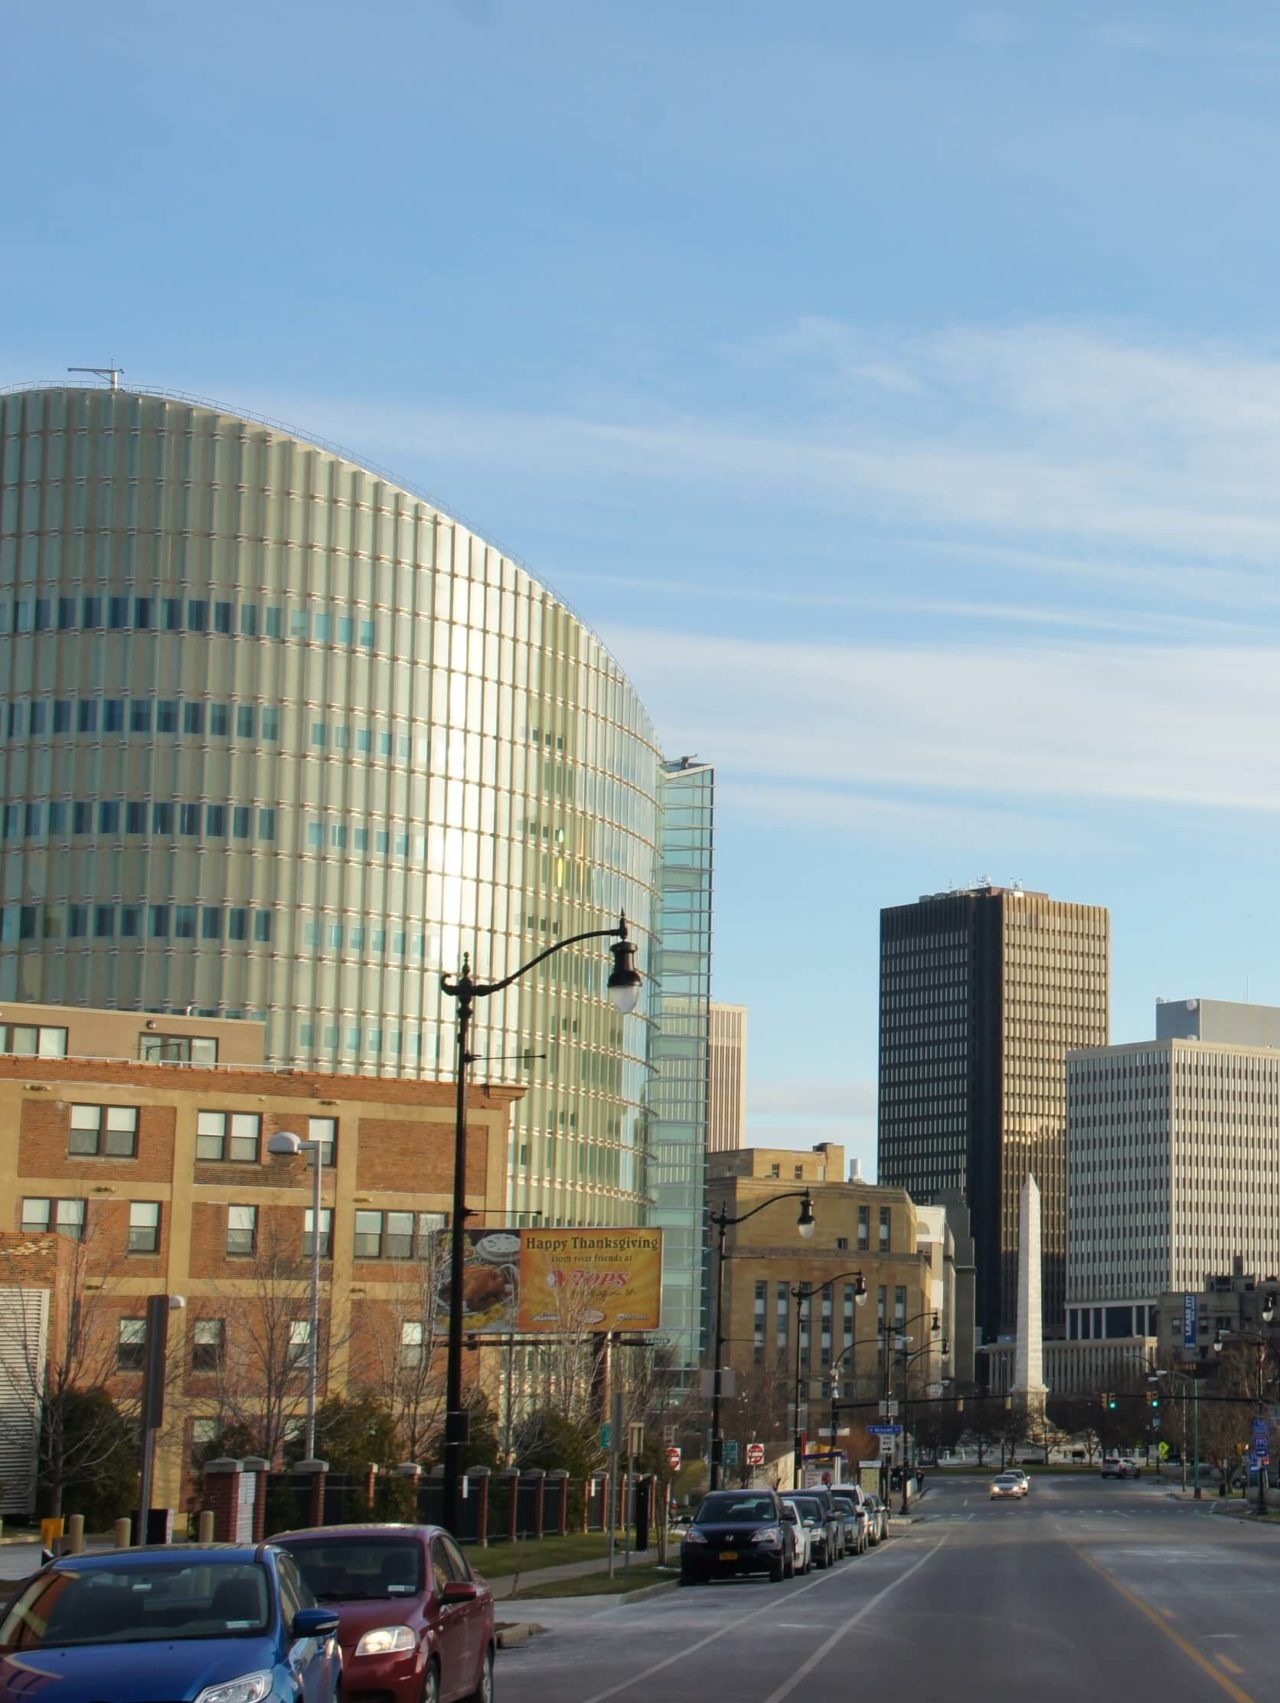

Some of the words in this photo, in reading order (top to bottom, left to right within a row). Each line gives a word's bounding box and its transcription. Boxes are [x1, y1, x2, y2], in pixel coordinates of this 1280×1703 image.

[526, 1237, 568, 1251] Happy
[571, 1236, 658, 1251] Thanksgiving
[595, 1254, 621, 1263] friends
